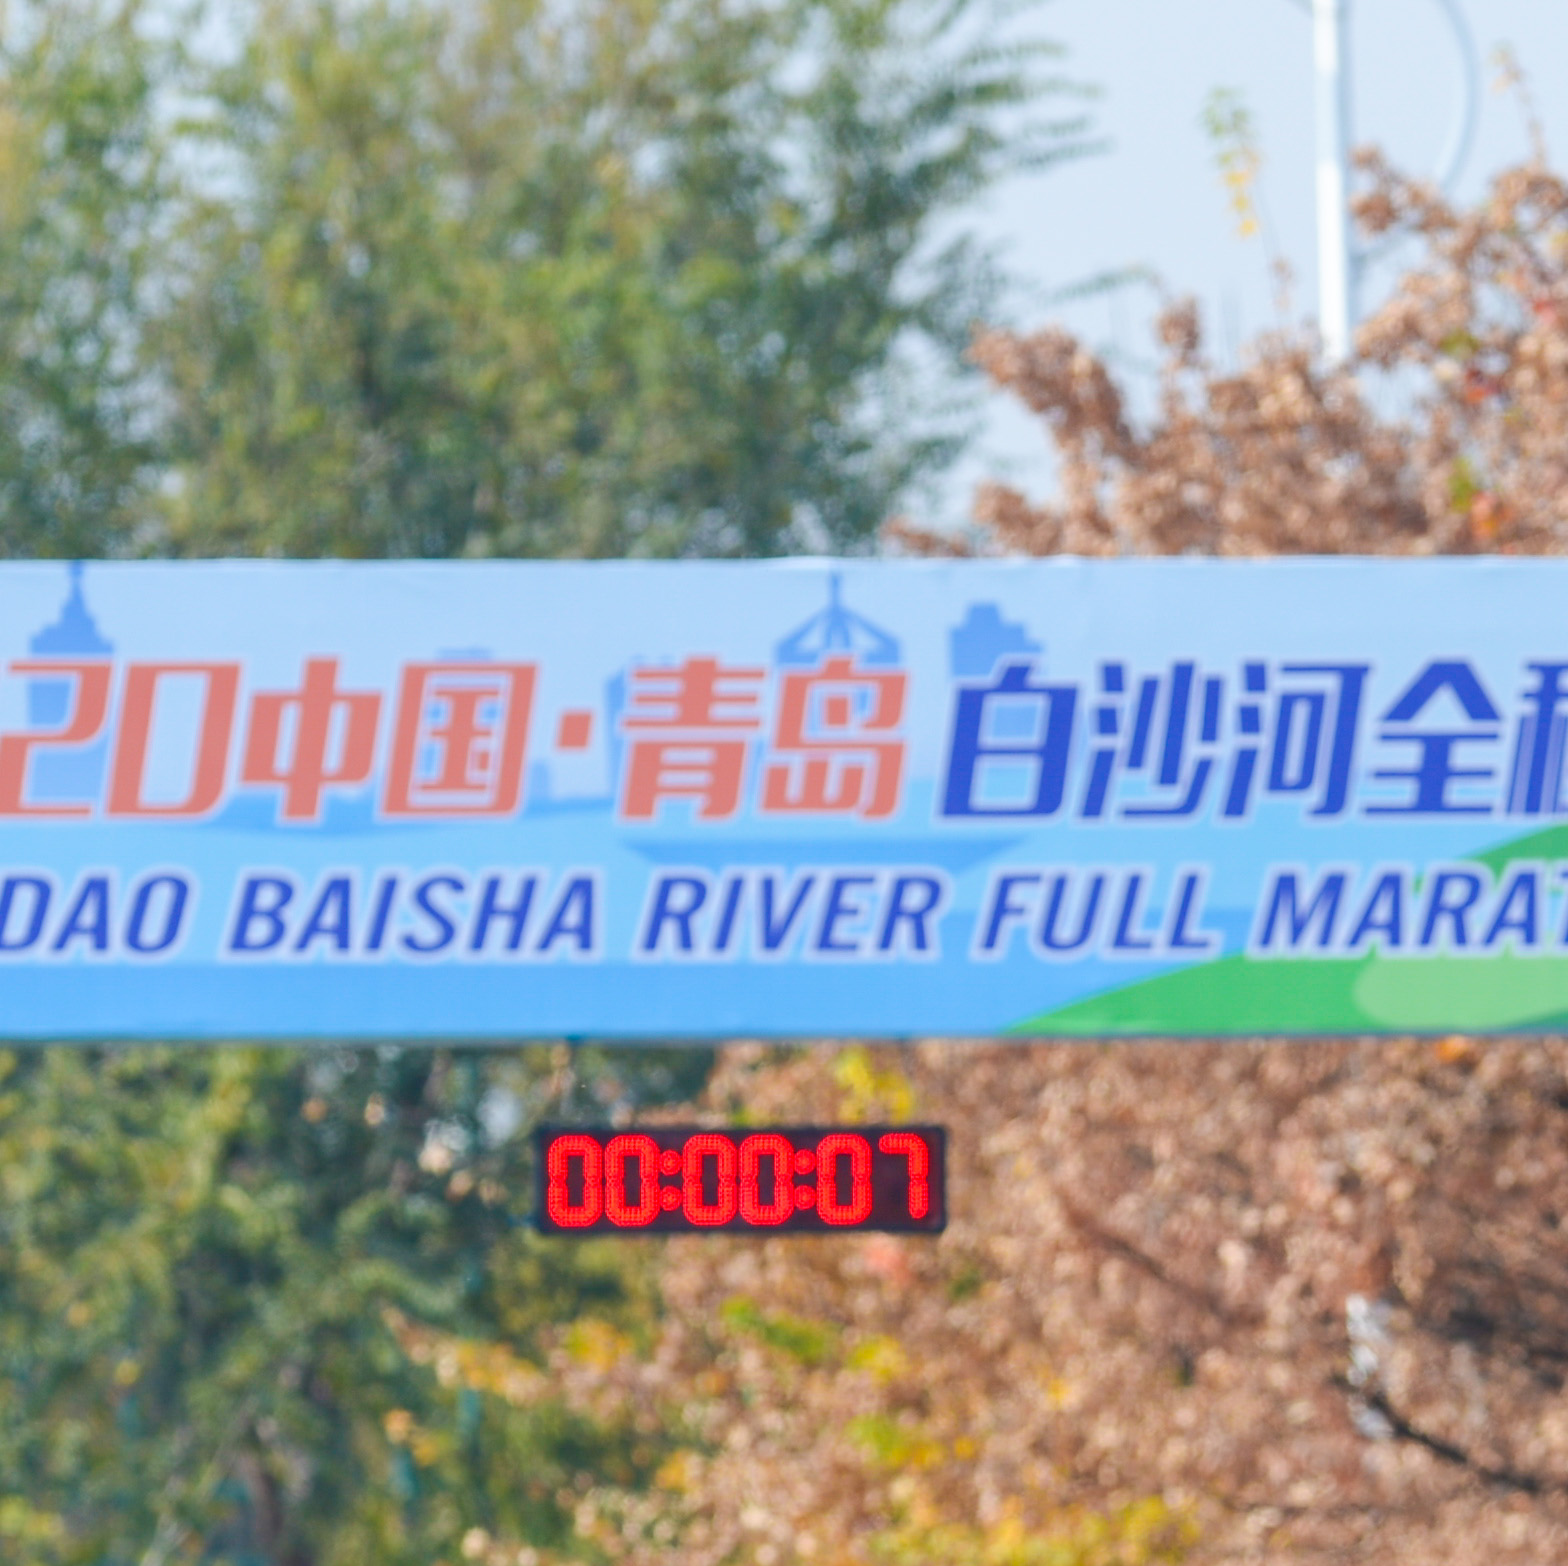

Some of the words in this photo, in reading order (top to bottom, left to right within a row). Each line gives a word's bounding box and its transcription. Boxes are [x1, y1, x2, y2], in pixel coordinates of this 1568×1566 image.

[226, 874, 599, 954] BAISHA
[643, 874, 942, 954] RIVER
[980, 873, 1211, 951] FULL
[548, 1133, 929, 1228] 00:00:07
